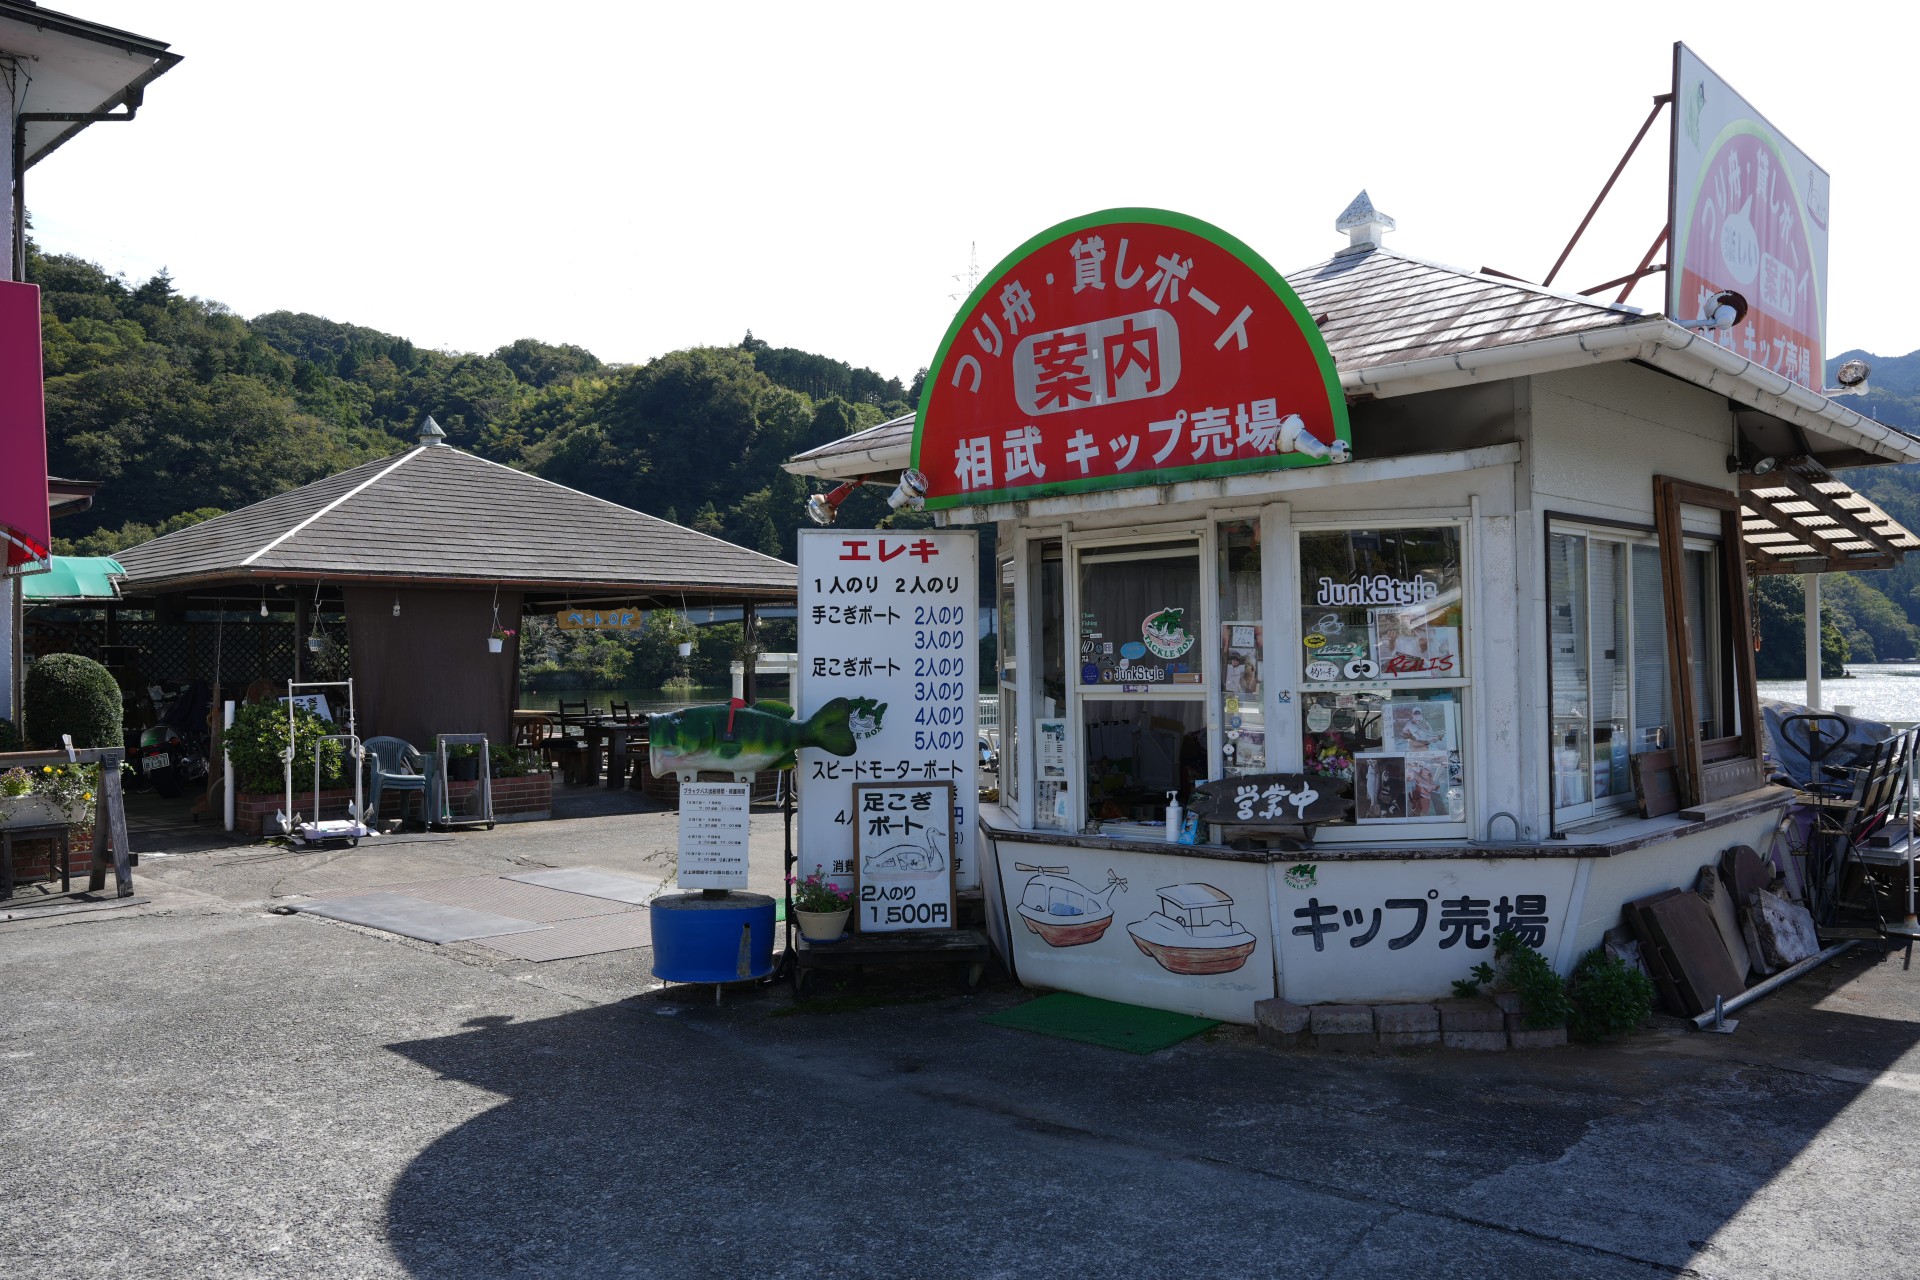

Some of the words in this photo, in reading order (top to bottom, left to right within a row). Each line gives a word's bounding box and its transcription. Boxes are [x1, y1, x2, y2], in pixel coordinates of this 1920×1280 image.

[1764, 257, 1793, 314] 案内
[952, 235, 1254, 393] つり舟・貸しボート
[1032, 319, 1163, 411] 案内
[954, 425, 1046, 490] 相武
[1066, 397, 1280, 475] キップ売場
[839, 539, 939, 563] エレキ
[815, 576, 878, 594] 1人のり
[896, 576, 959, 594] 2人のり
[1317, 574, 1437, 606] JunkStyle
[608, 612, 634, 626] OK
[812, 605, 901, 625] 手こぎボート
[914, 606, 964, 625] 2人のり
[914, 630, 964, 650] 3人のり
[1144, 634, 1176, 658] TACKLE
[1177, 639, 1193, 655] BOX
[812, 657, 901, 677] 足こぎボート
[914, 657, 964, 677] 2人のり
[1114, 665, 1165, 683] JunkStyle
[1385, 654, 1454, 678] REALIS
[914, 682, 964, 701] 3人のり
[914, 706, 964, 725] 4人のり
[865, 725, 883, 739] BOX
[914, 731, 964, 750] 5人のり
[812, 760, 963, 780] スピードモーターボート
[863, 791, 932, 812] 足こぎ
[1233, 780, 1320, 820] 営業中
[868, 815, 924, 836] ボート
[862, 886, 916, 901] 2人のり
[1292, 889, 1550, 952] キップ売場
